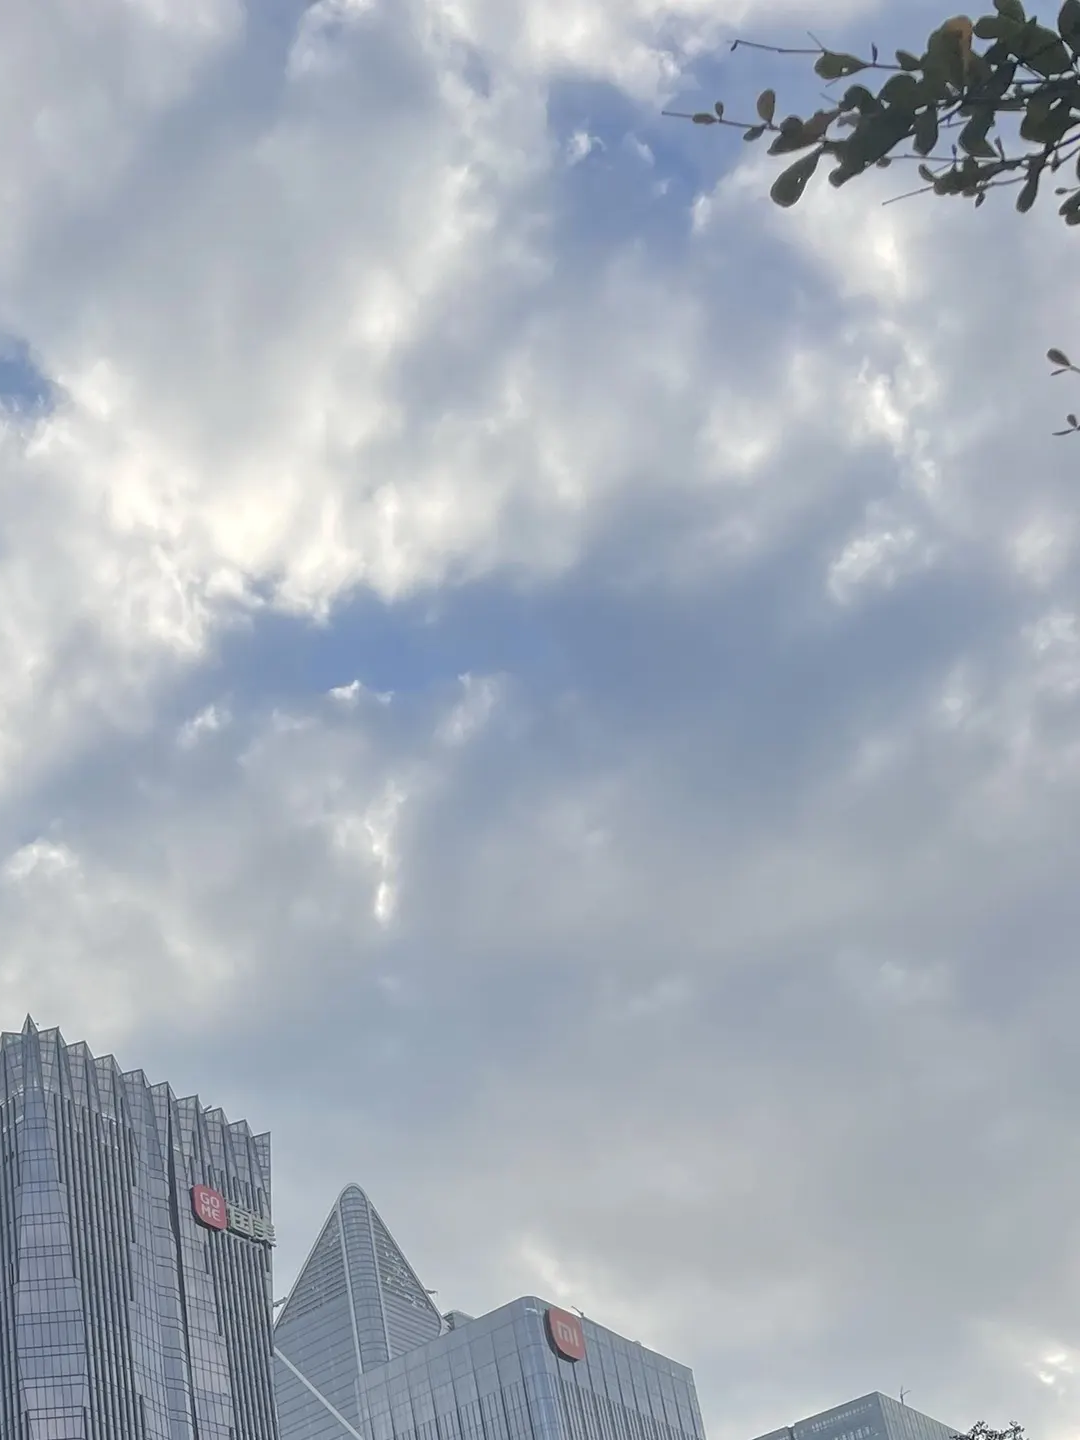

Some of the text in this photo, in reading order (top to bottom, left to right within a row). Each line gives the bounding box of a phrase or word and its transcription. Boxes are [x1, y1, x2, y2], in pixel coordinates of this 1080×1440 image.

[200, 1191, 220, 1209] GO
[201, 1203, 221, 1222] ME
[229, 1205, 276, 1247] 国美
